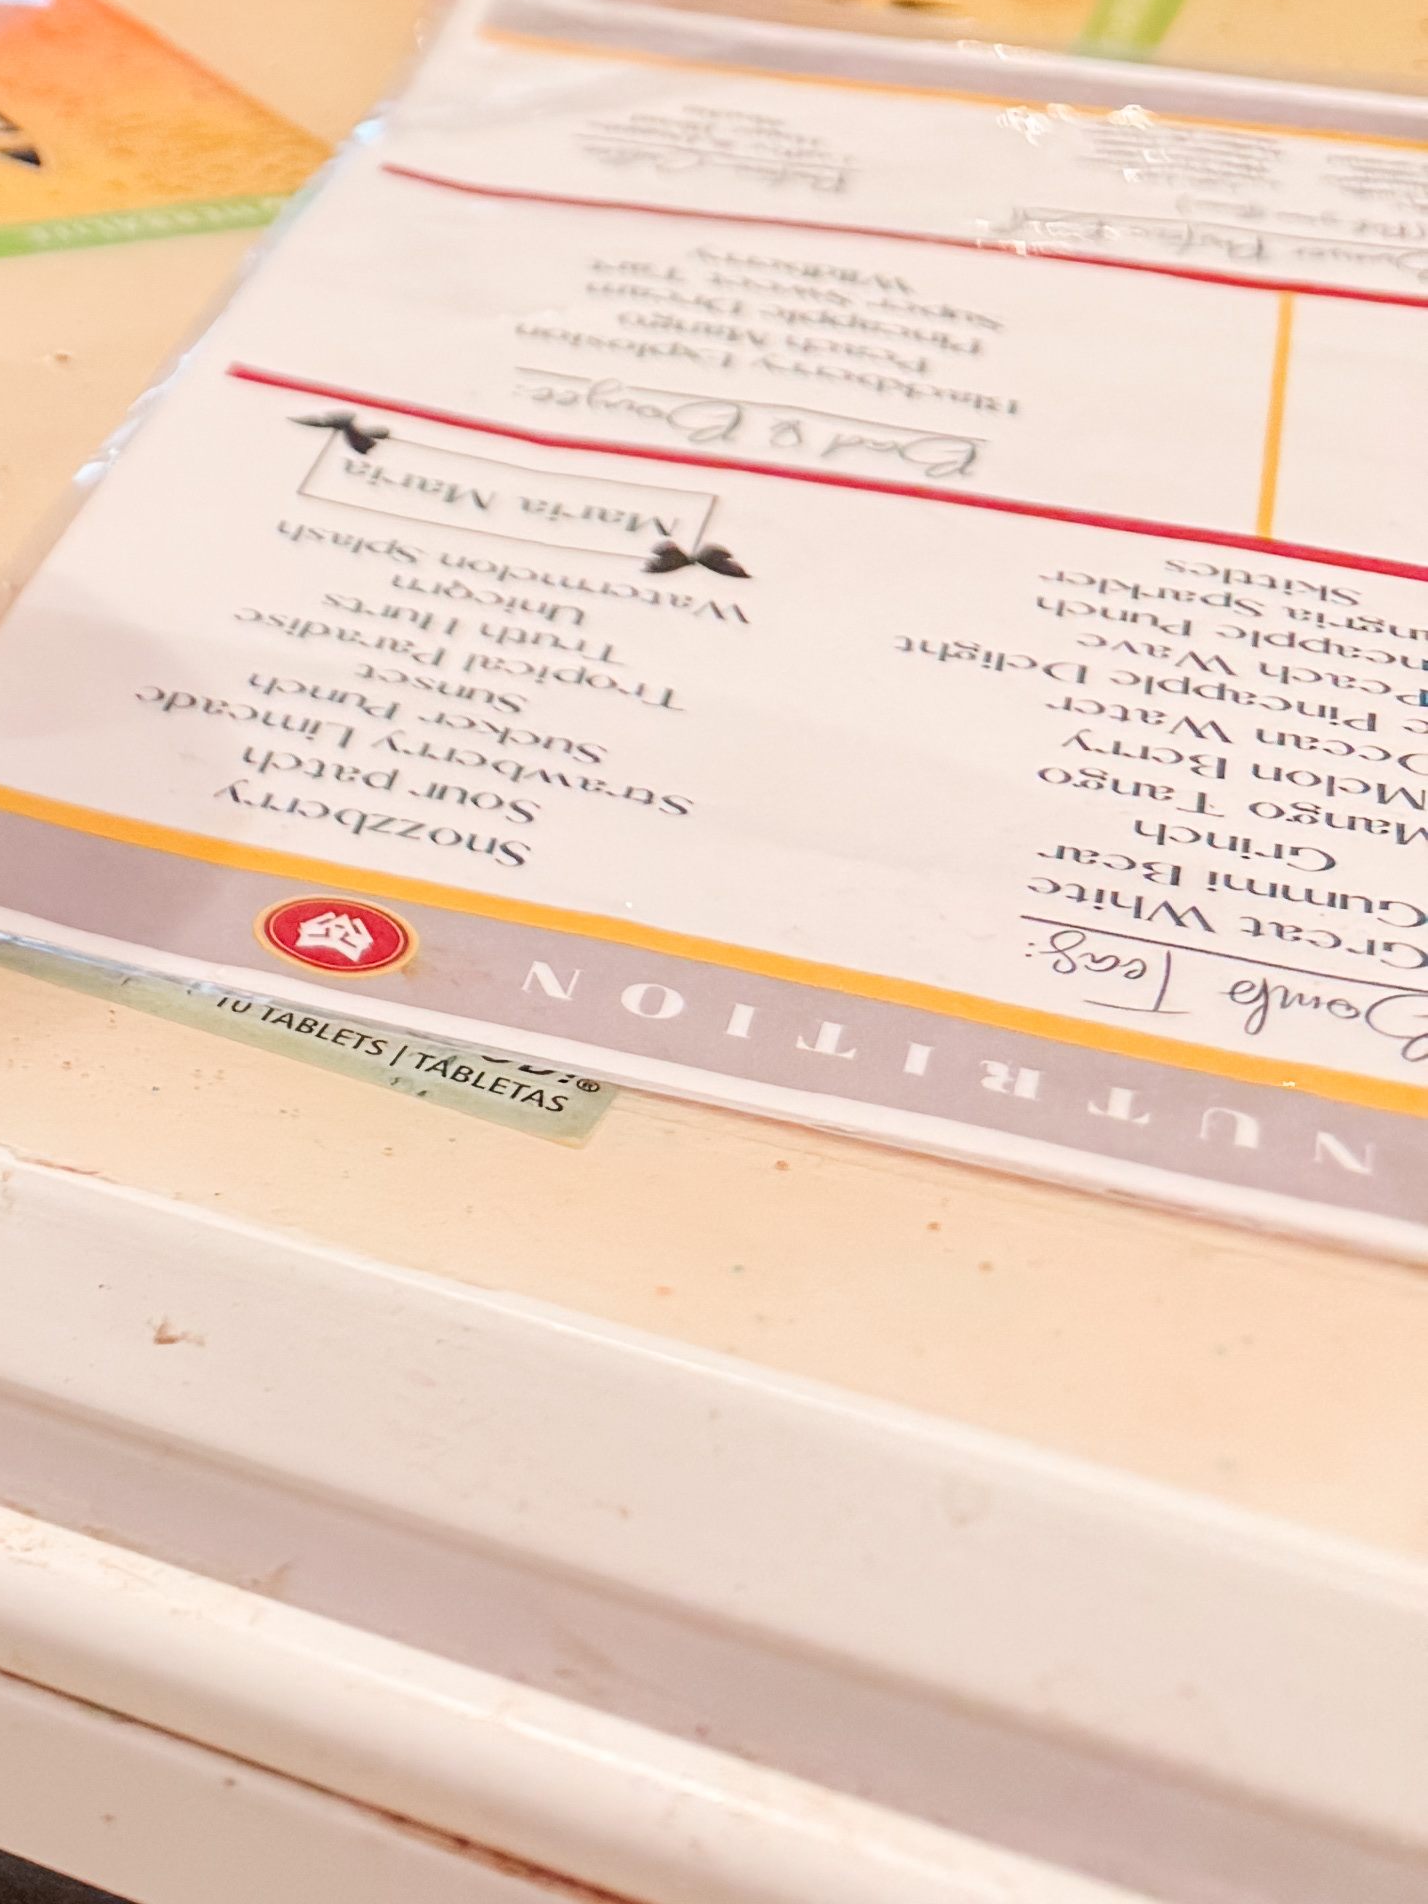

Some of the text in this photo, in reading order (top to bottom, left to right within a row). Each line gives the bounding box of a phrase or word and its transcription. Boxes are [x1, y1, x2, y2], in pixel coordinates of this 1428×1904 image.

[616, 312, 768, 351] Mango
[819, 434, 978, 479] Bad
[340, 455, 679, 541] Maria Maria
[274, 518, 750, 625] Watermelon Splash
[388, 572, 587, 627] Unicorn
[1037, 568, 1264, 619] Sparkler
[1163, 558, 1361, 608] Skittles
[232, 604, 685, 712] Tropical Paradise
[319, 591, 623, 665] Truth Hurts
[1035, 595, 1428, 672] neapple Punch
[353, 662, 527, 714] Sunset
[893, 634, 1377, 733] Pineapple Delight
[1075, 632, 1428, 708] Peach Wave
[133, 683, 694, 817] Strawberry Limeade
[245, 671, 607, 765] Sucker Punch
[1044, 696, 1233, 745] Water
[240, 744, 540, 825] Sour patch
[1037, 766, 1224, 818] Tango
[1060, 729, 1426, 813] Melon Berry
[212, 779, 531, 869] Snozzberry
[1133, 818, 1336, 873] Grinch
[1026, 876, 1428, 971] Great White
[1036, 844, 1428, 929] Gummi Bear
[1023, 929, 1428, 1063] Bomb Teas:
[257, 1006, 385, 1059] TABLETS
[414, 1050, 570, 1114] TABLETAS
[519, 959, 1374, 1175] NUTRITION
